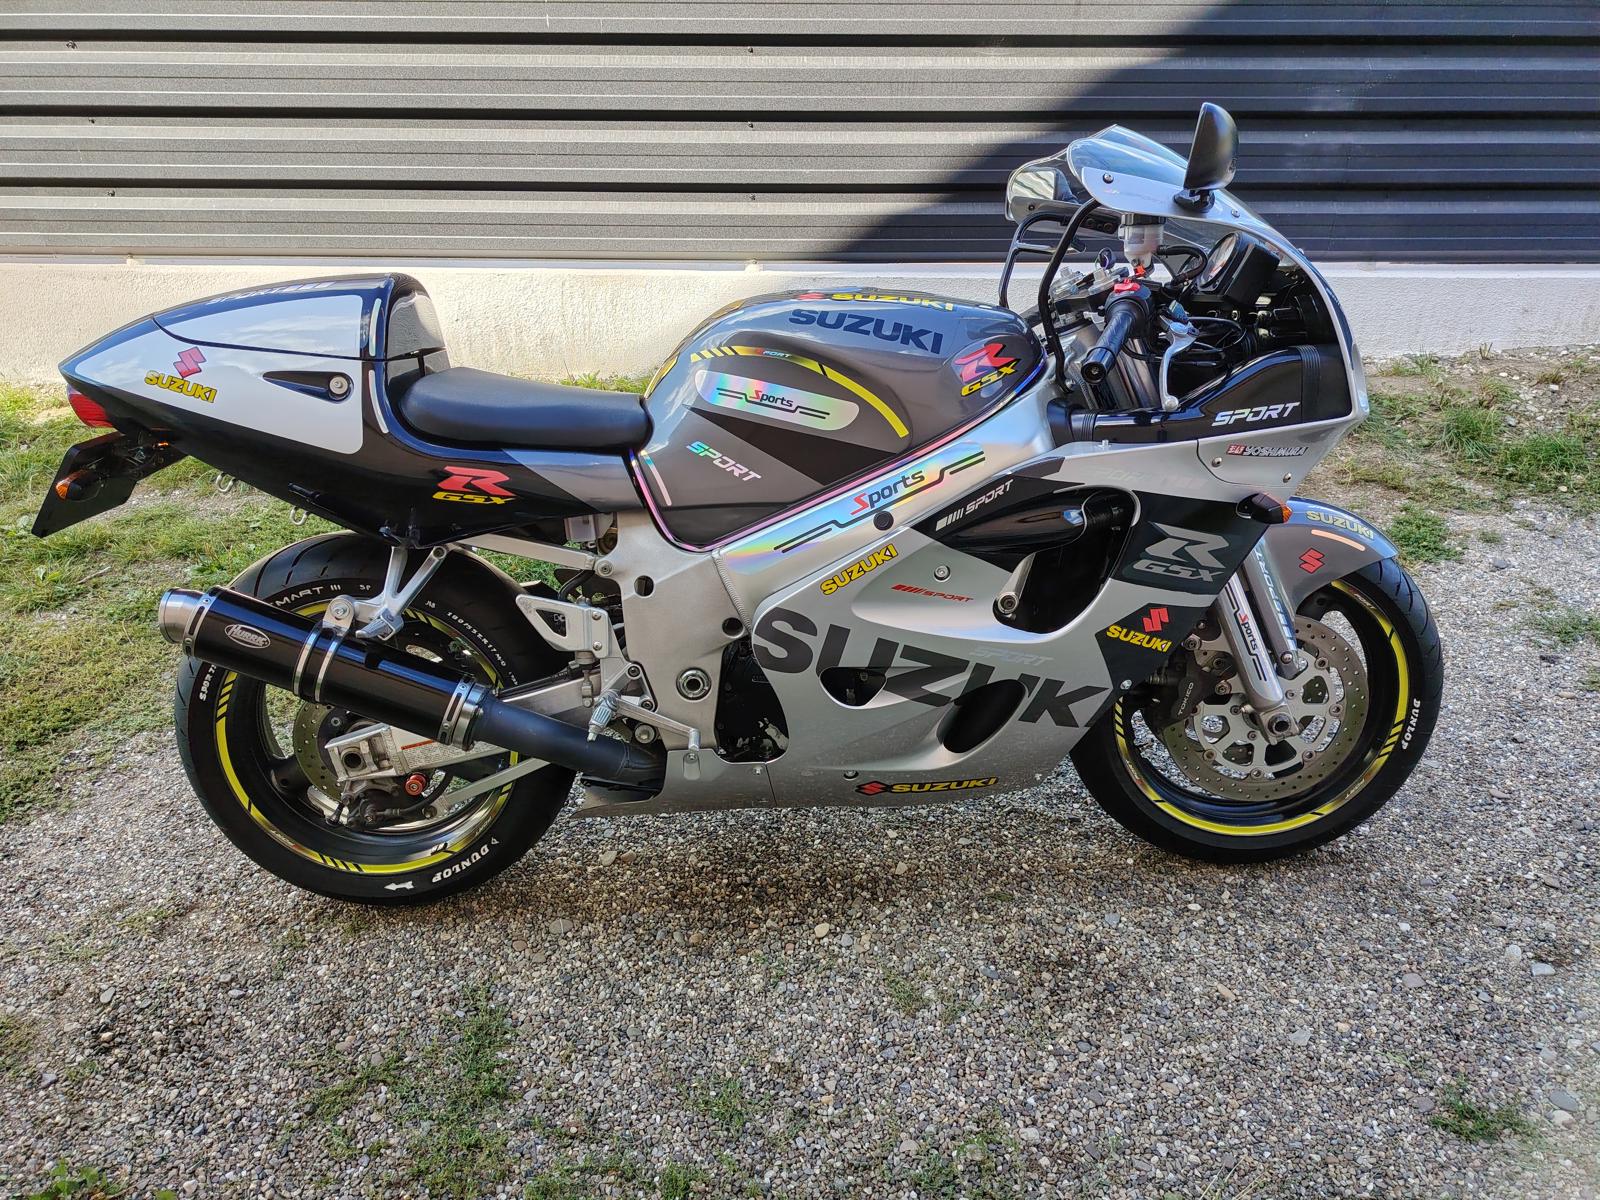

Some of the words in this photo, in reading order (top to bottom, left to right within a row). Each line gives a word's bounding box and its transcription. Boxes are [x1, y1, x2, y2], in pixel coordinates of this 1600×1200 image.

[832, 293, 954, 311] SUZUKI
[788, 309, 943, 354] SUZUKI
[144, 370, 218, 403] SUZUKI
[960, 360, 1021, 396] GSX
[753, 388, 794, 408] Sports
[1212, 402, 1301, 427] SPORT
[686, 441, 762, 482] SPORT
[432, 490, 517, 505] GSX
[850, 470, 925, 516] Sports
[965, 480, 1014, 515] SPORT
[1305, 510, 1376, 540] SUZUKI
[820, 543, 899, 596] SUZUKI
[1132, 559, 1224, 583] GSX
[269, 586, 324, 607] MART
[924, 589, 974, 603] SPORT
[1106, 625, 1173, 653] SUZUKI
[1238, 613, 1258, 651] Sports
[753, 607, 1110, 728] SUZUK
[1401, 698, 1421, 750] DUNLOP
[890, 777, 1000, 794] SUZUKI
[432, 844, 490, 883] DUNLOP
